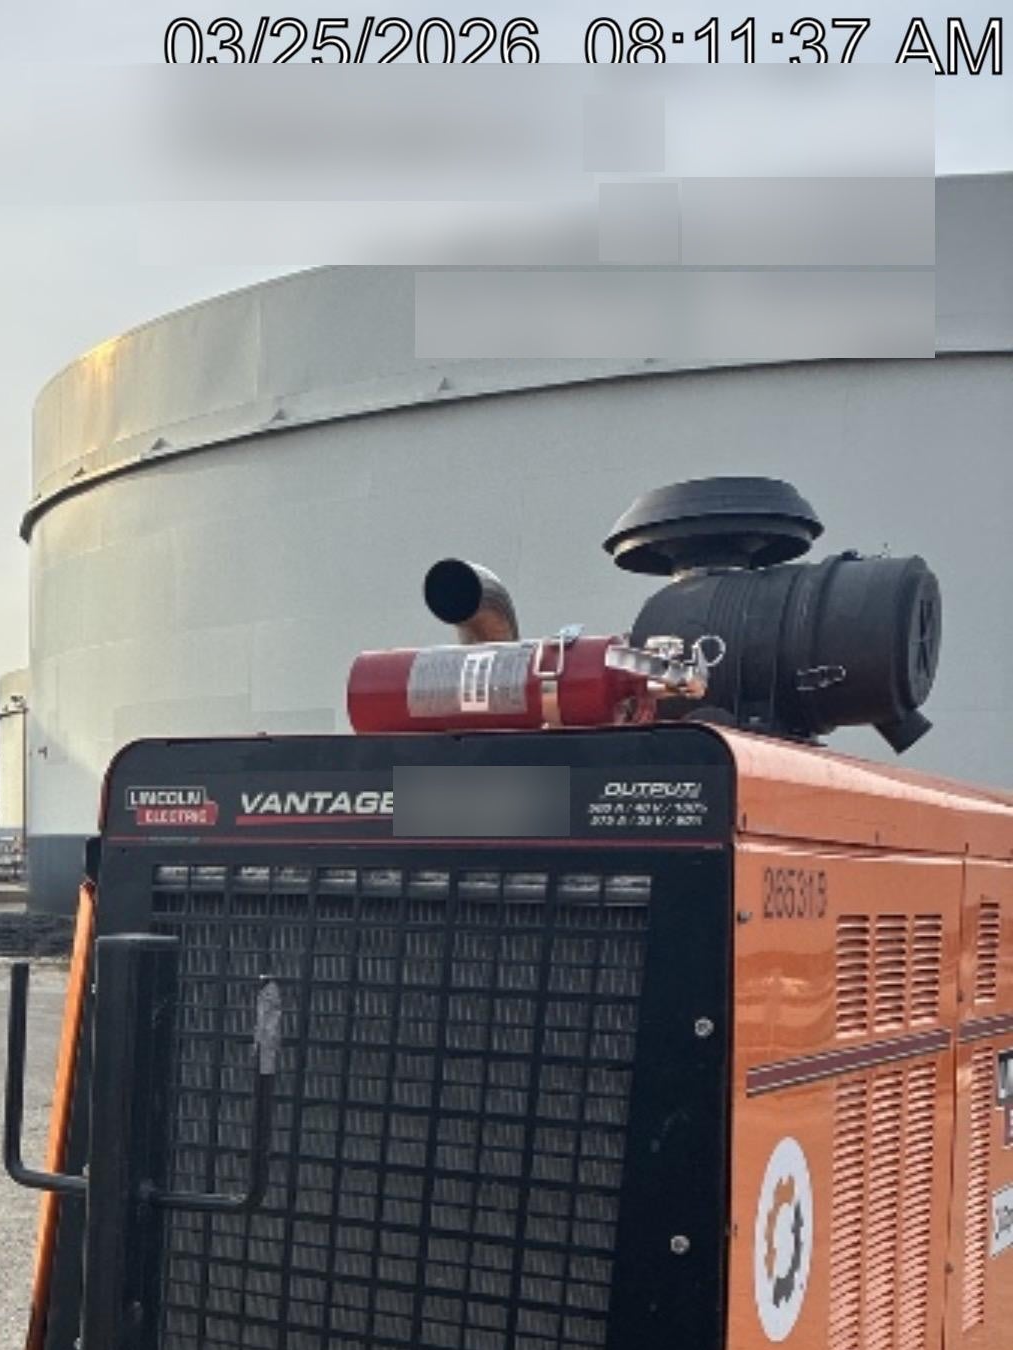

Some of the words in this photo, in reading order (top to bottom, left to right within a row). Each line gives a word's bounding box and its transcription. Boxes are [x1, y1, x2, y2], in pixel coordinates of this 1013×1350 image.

[129, 790, 202, 806] LINCOLN
[603, 782, 697, 798] OUTPUT
[240, 790, 394, 815] VANTAGE
[145, 809, 207, 823] ELECTRIC
